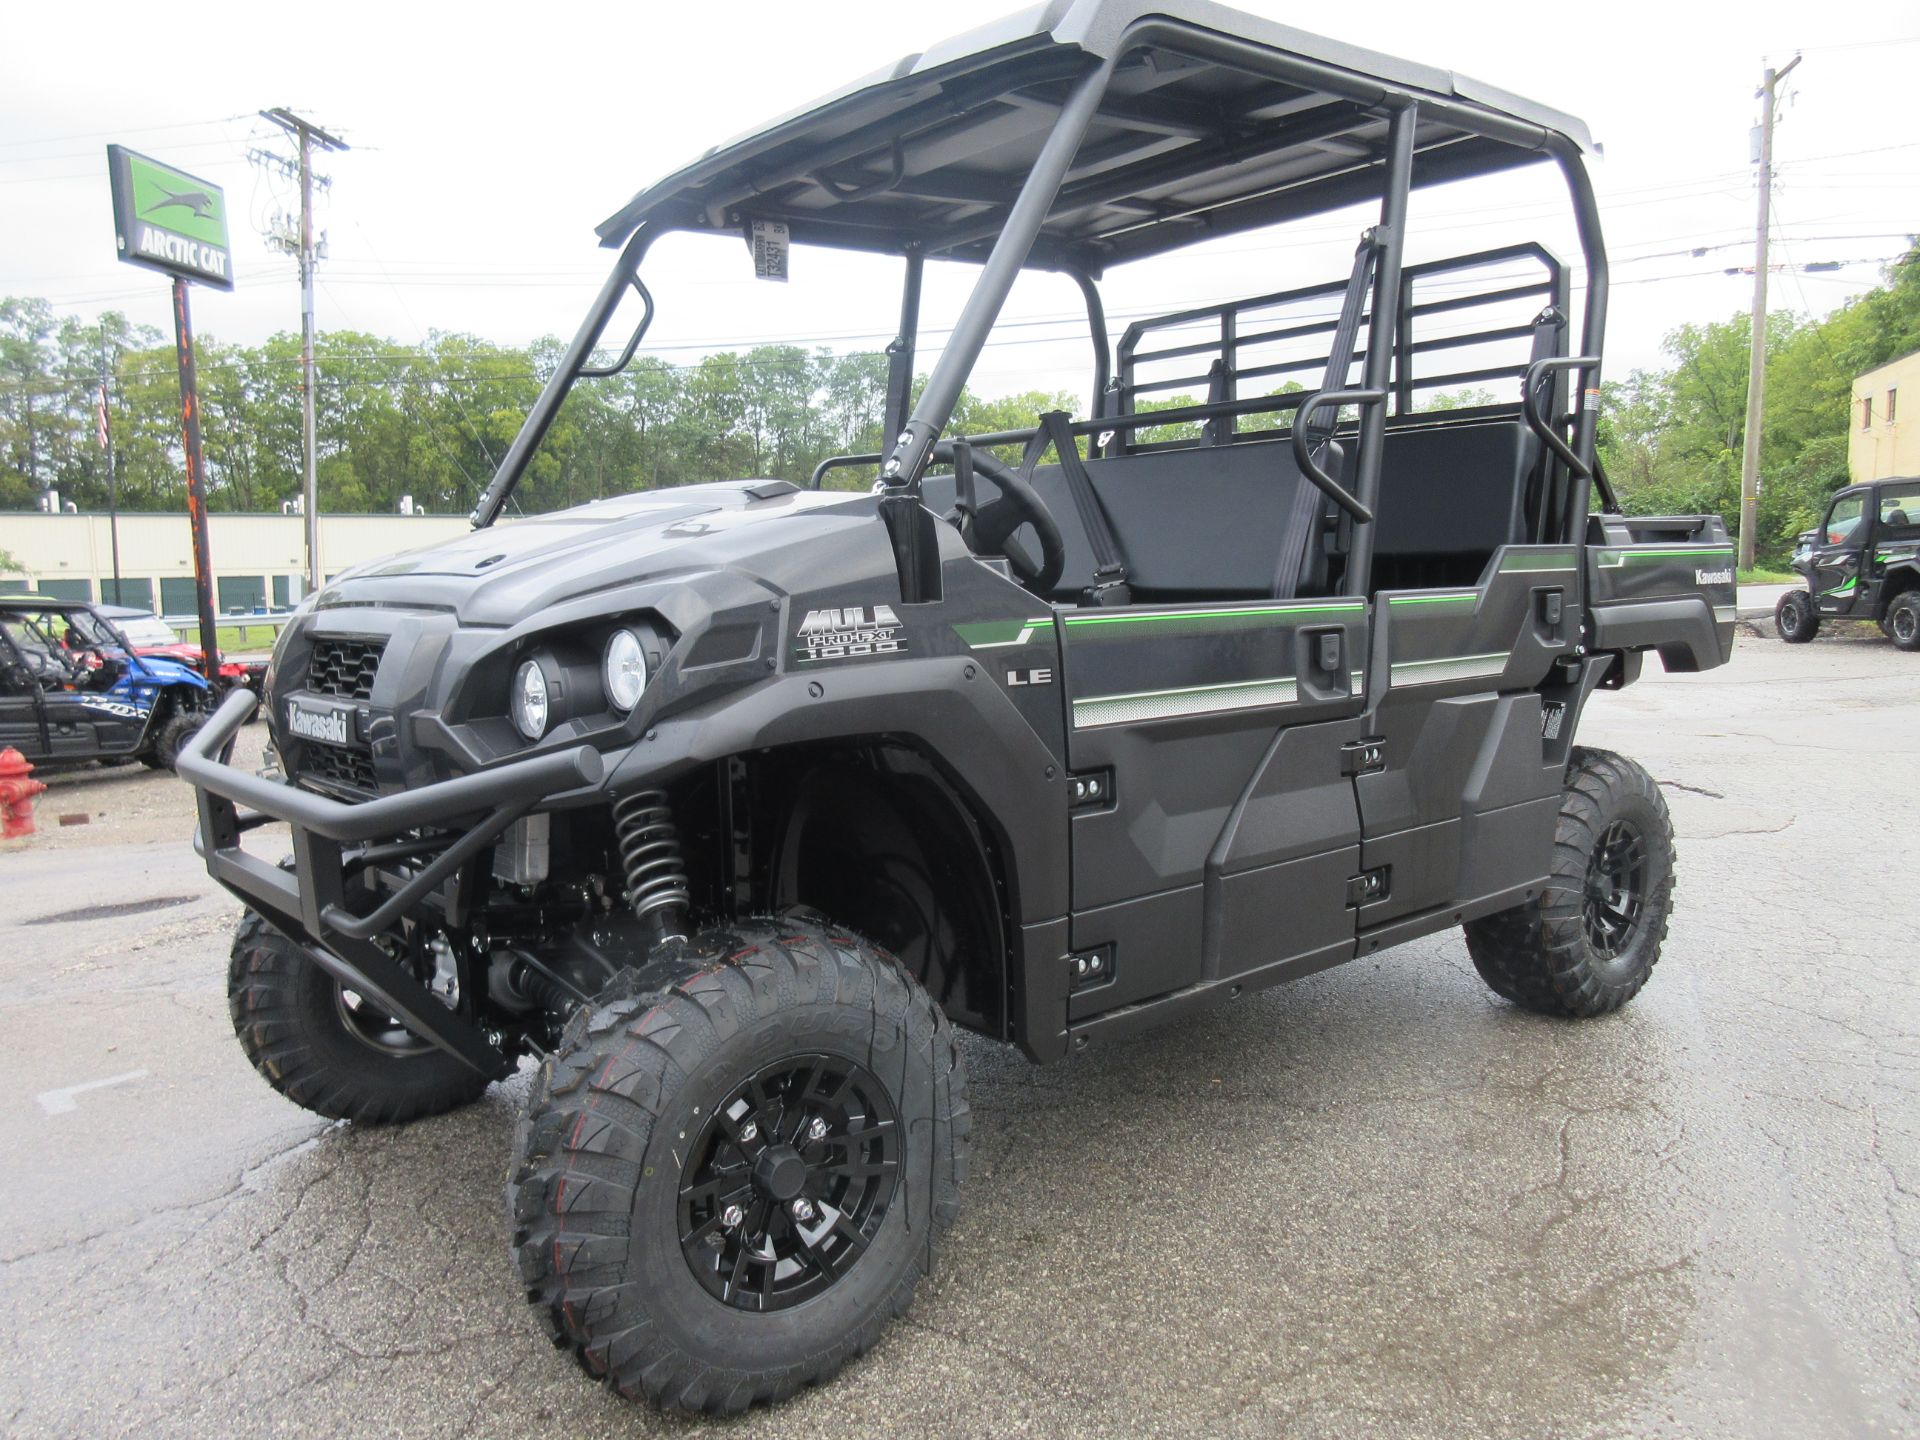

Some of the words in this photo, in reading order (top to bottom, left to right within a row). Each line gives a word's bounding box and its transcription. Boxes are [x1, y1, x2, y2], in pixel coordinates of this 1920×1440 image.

[141, 227, 198, 267] ARCTIC
[200, 247, 226, 276] CAT
[1695, 568, 1732, 585] Kawasaki
[807, 641, 898, 659] 1000
[1007, 668, 1052, 686] LE
[289, 702, 347, 743] Kawasaki
